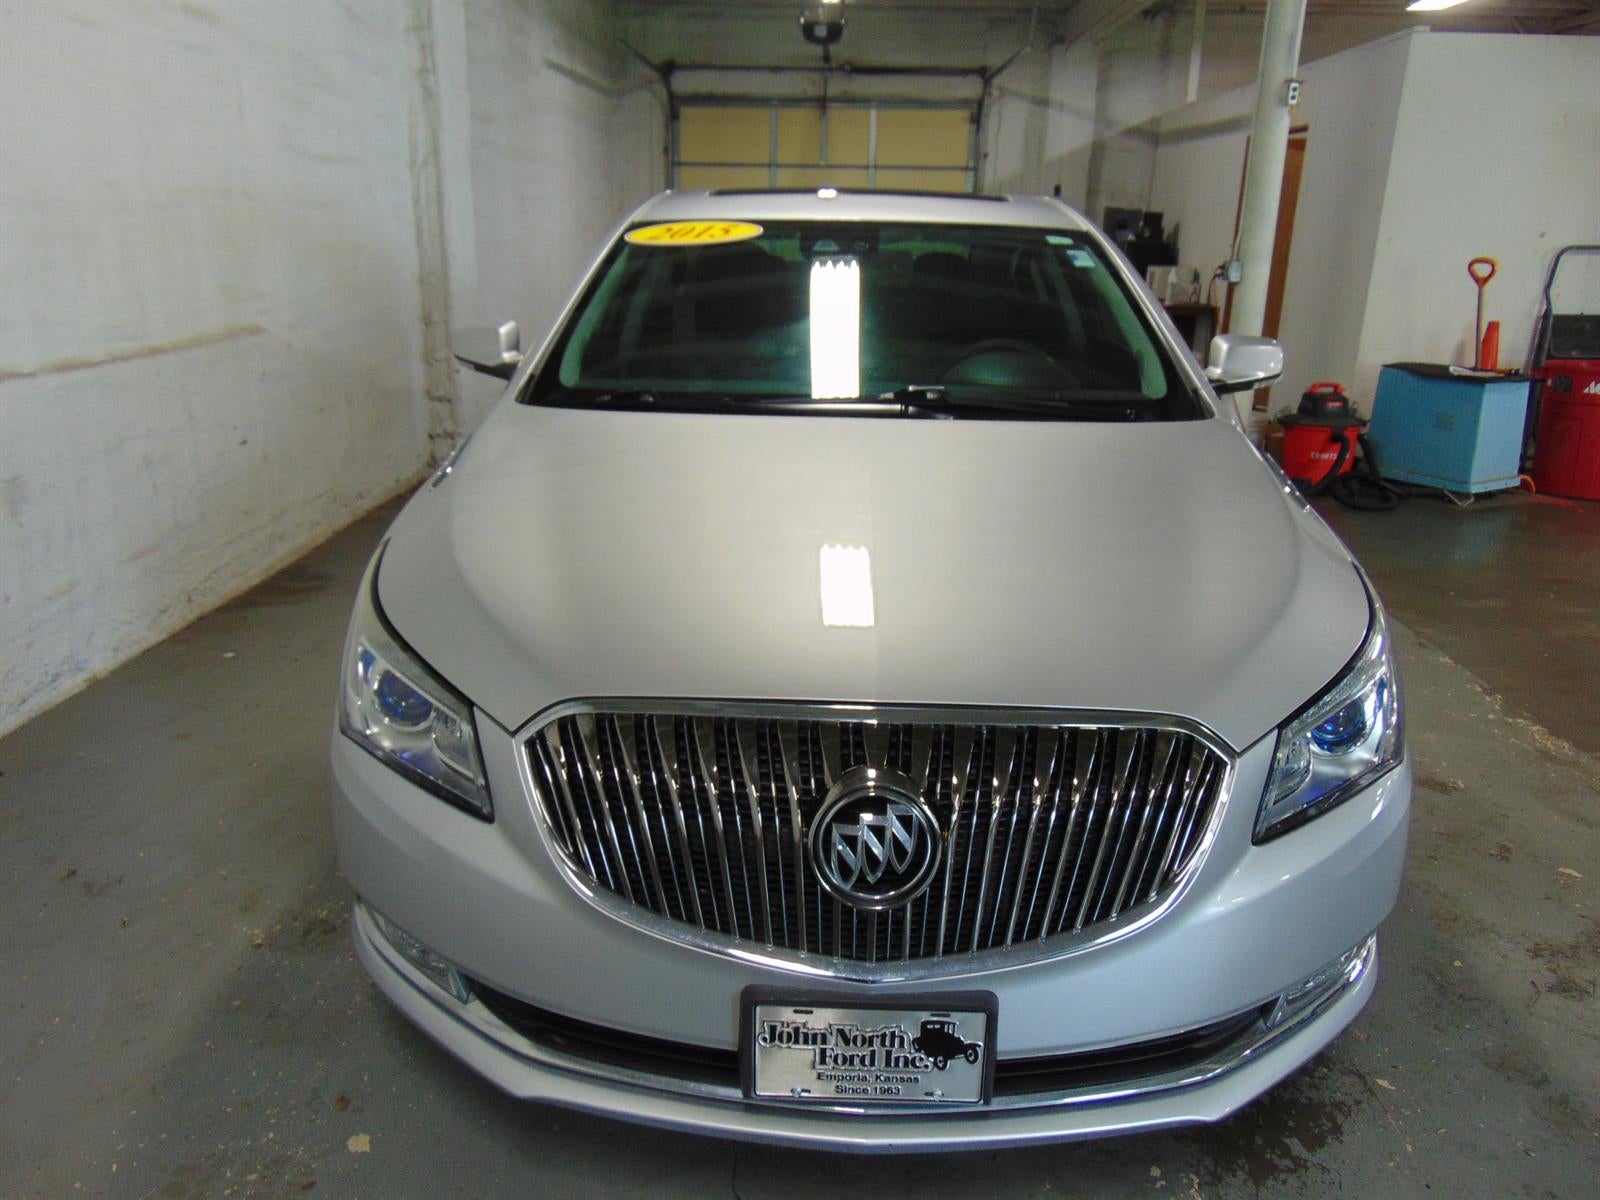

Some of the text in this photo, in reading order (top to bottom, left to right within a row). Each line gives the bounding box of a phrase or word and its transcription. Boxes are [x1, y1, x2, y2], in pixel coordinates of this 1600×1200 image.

[646, 223, 740, 241] 2015
[758, 1021, 909, 1049] John North
[815, 1047, 931, 1071] Ford Inc.
[816, 1072, 920, 1083] Emporia, Kansas
[835, 1085, 901, 1095] Since 1963
